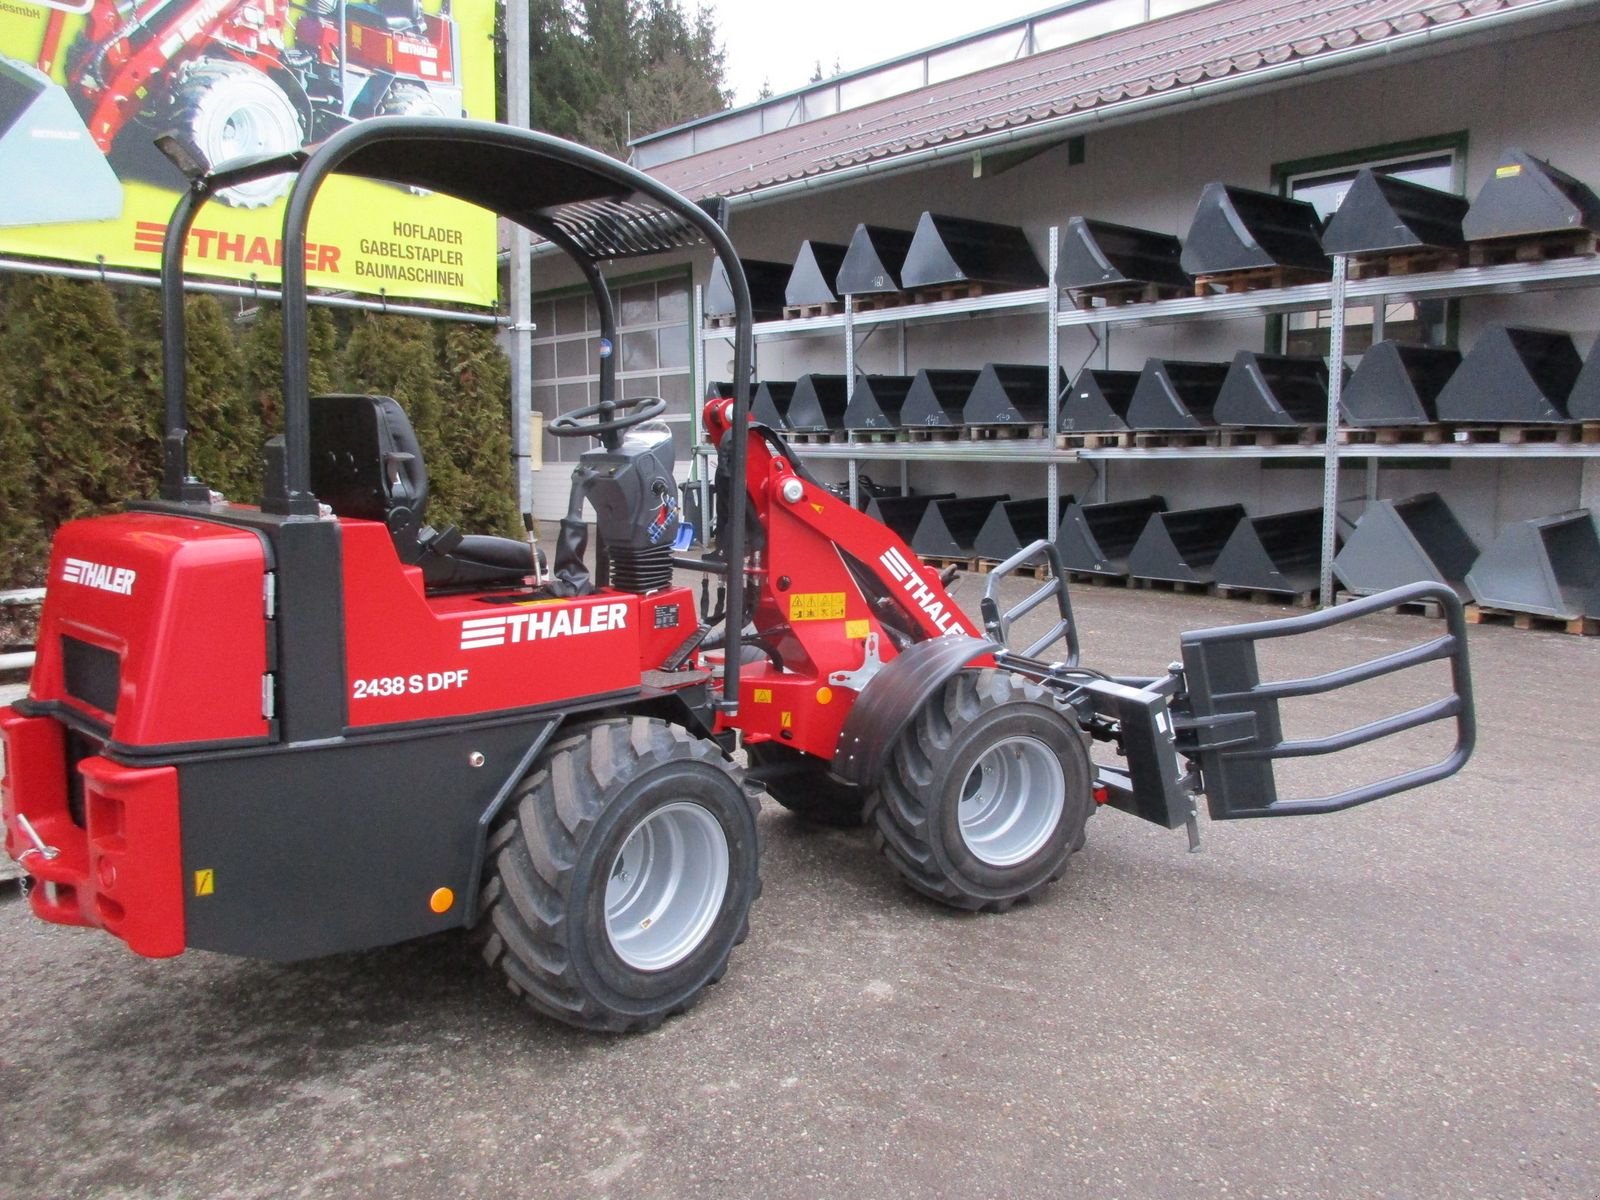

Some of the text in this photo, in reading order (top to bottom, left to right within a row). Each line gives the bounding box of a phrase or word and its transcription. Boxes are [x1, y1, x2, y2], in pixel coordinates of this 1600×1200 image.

[393, 221, 462, 245] HOFLADER
[360, 238, 463, 266] GABELSTAPLER
[355, 260, 464, 287] BAUMASCHINEN
[79, 560, 136, 596] THALER
[903, 571, 968, 637] THALE
[506, 602, 628, 643] THALER
[353, 669, 469, 699] 2438 S DPF
